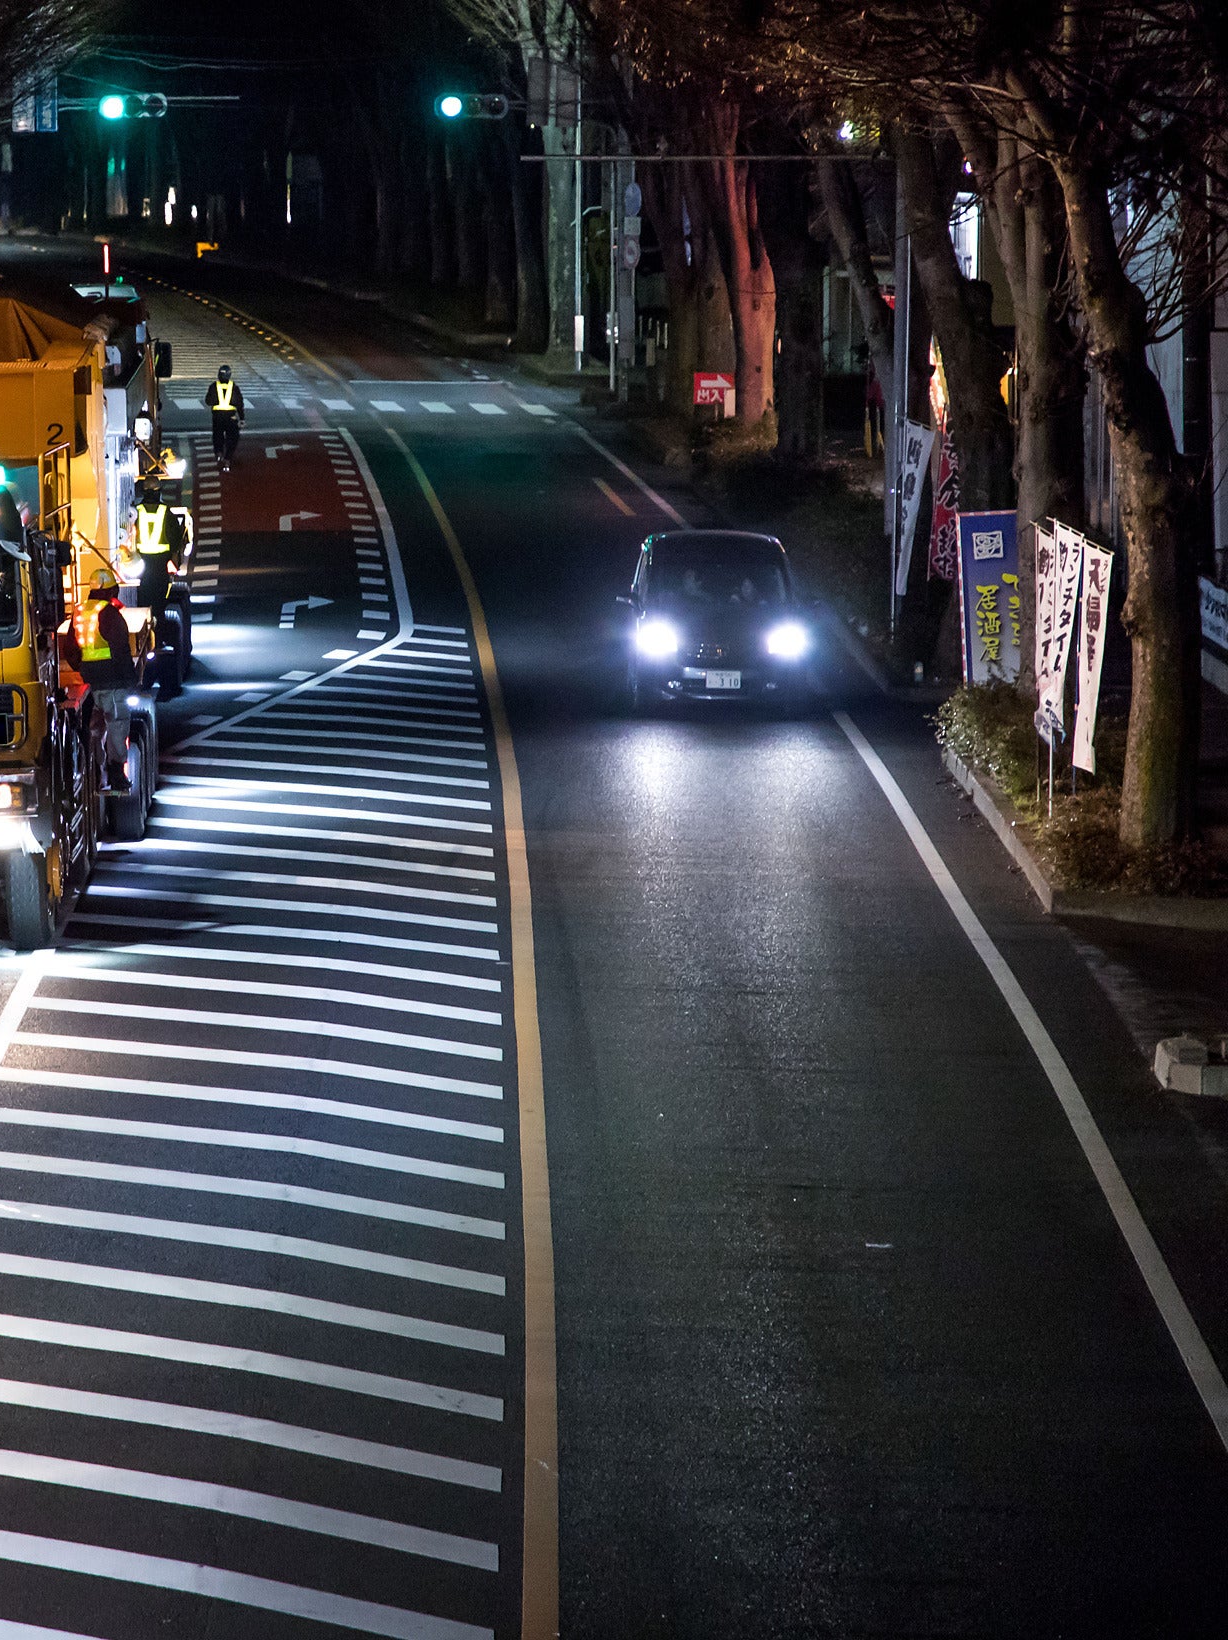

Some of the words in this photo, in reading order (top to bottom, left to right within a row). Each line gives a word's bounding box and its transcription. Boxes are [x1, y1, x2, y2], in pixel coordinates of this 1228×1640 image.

[697, 389, 725, 403] 出入
[47, 422, 64, 446] 2
[975, 584, 1003, 662] 居酒屋
